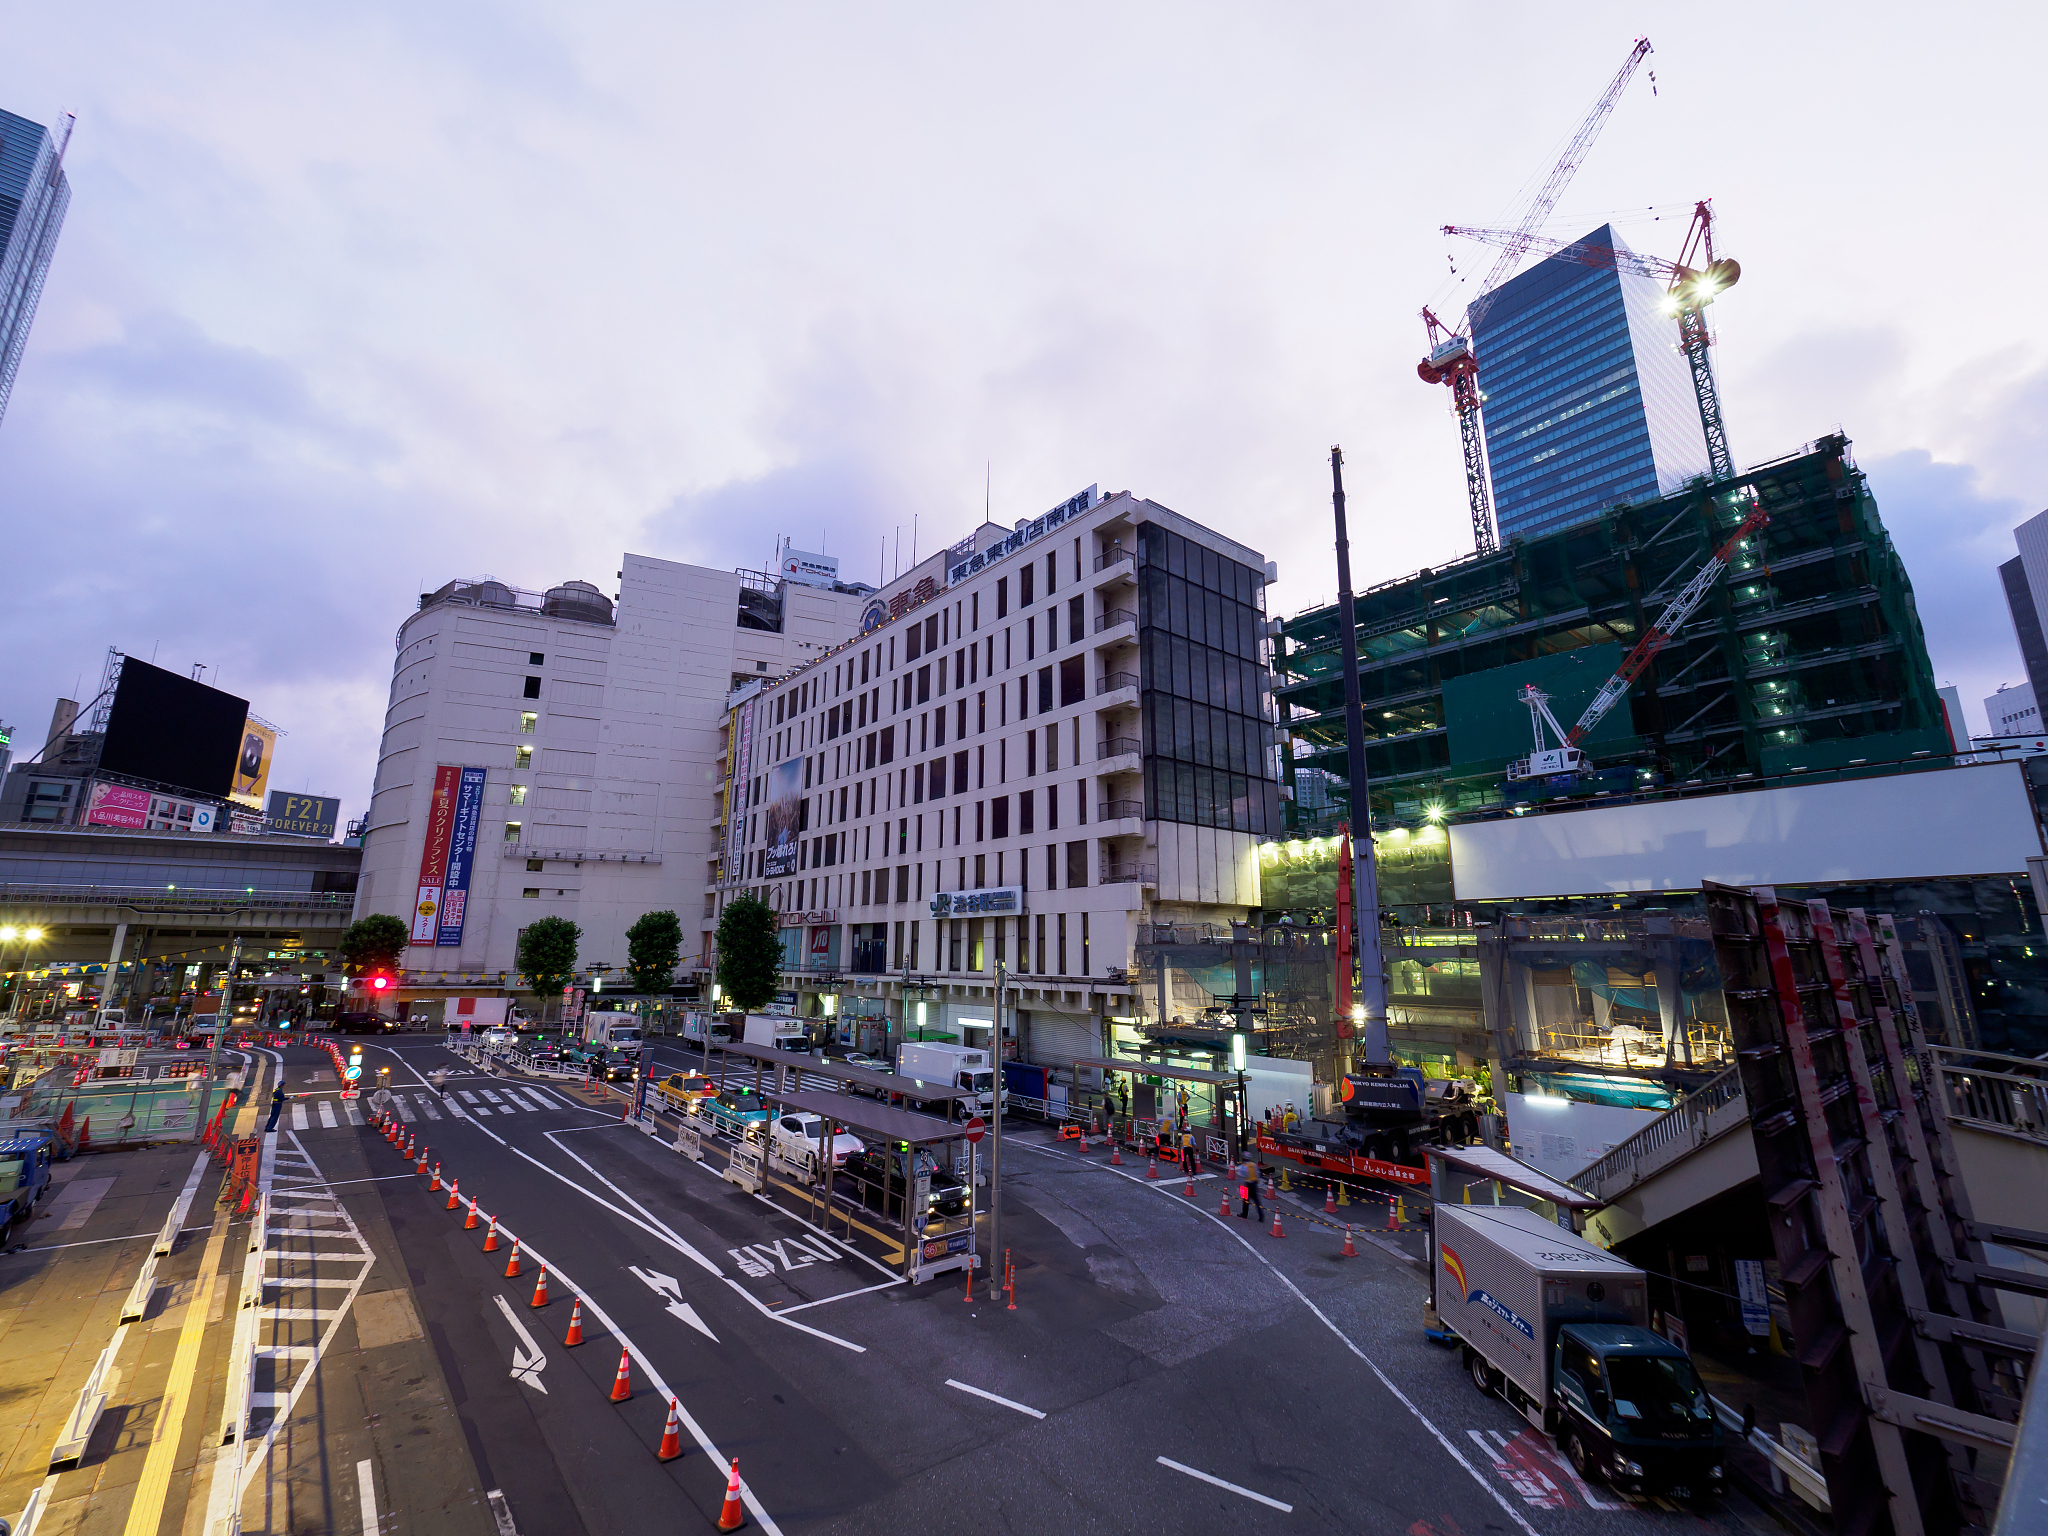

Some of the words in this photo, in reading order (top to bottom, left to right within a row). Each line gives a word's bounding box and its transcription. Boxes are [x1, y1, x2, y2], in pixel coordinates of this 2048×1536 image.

[951, 491, 1090, 584] 東急東横店南館
[799, 567, 837, 578] TOKYU
[118, 798, 144, 808] クリニック
[285, 797, 323, 820] F21
[97, 811, 143, 826] 品川美容外科
[321, 824, 333, 835] 21
[427, 797, 450, 875] 夏のクリアランス
[448, 784, 473, 888] サマーギフトセンター開設中
[765, 864, 786, 876] G-SHOCK
[421, 876, 443, 885] SALE
[425, 888, 434, 901] 予告
[930, 893, 952, 911] JR
[952, 893, 994, 913] 渋谷駅
[779, 909, 836, 925] TOKYU
[421, 917, 430, 939] スタート
[1287, 1146, 1308, 1155] DAIKYO
[1307, 1150, 1325, 1159] KENKI
[1560, 1215, 1569, 1230] 35
[925, 1245, 935, 1255] 36
